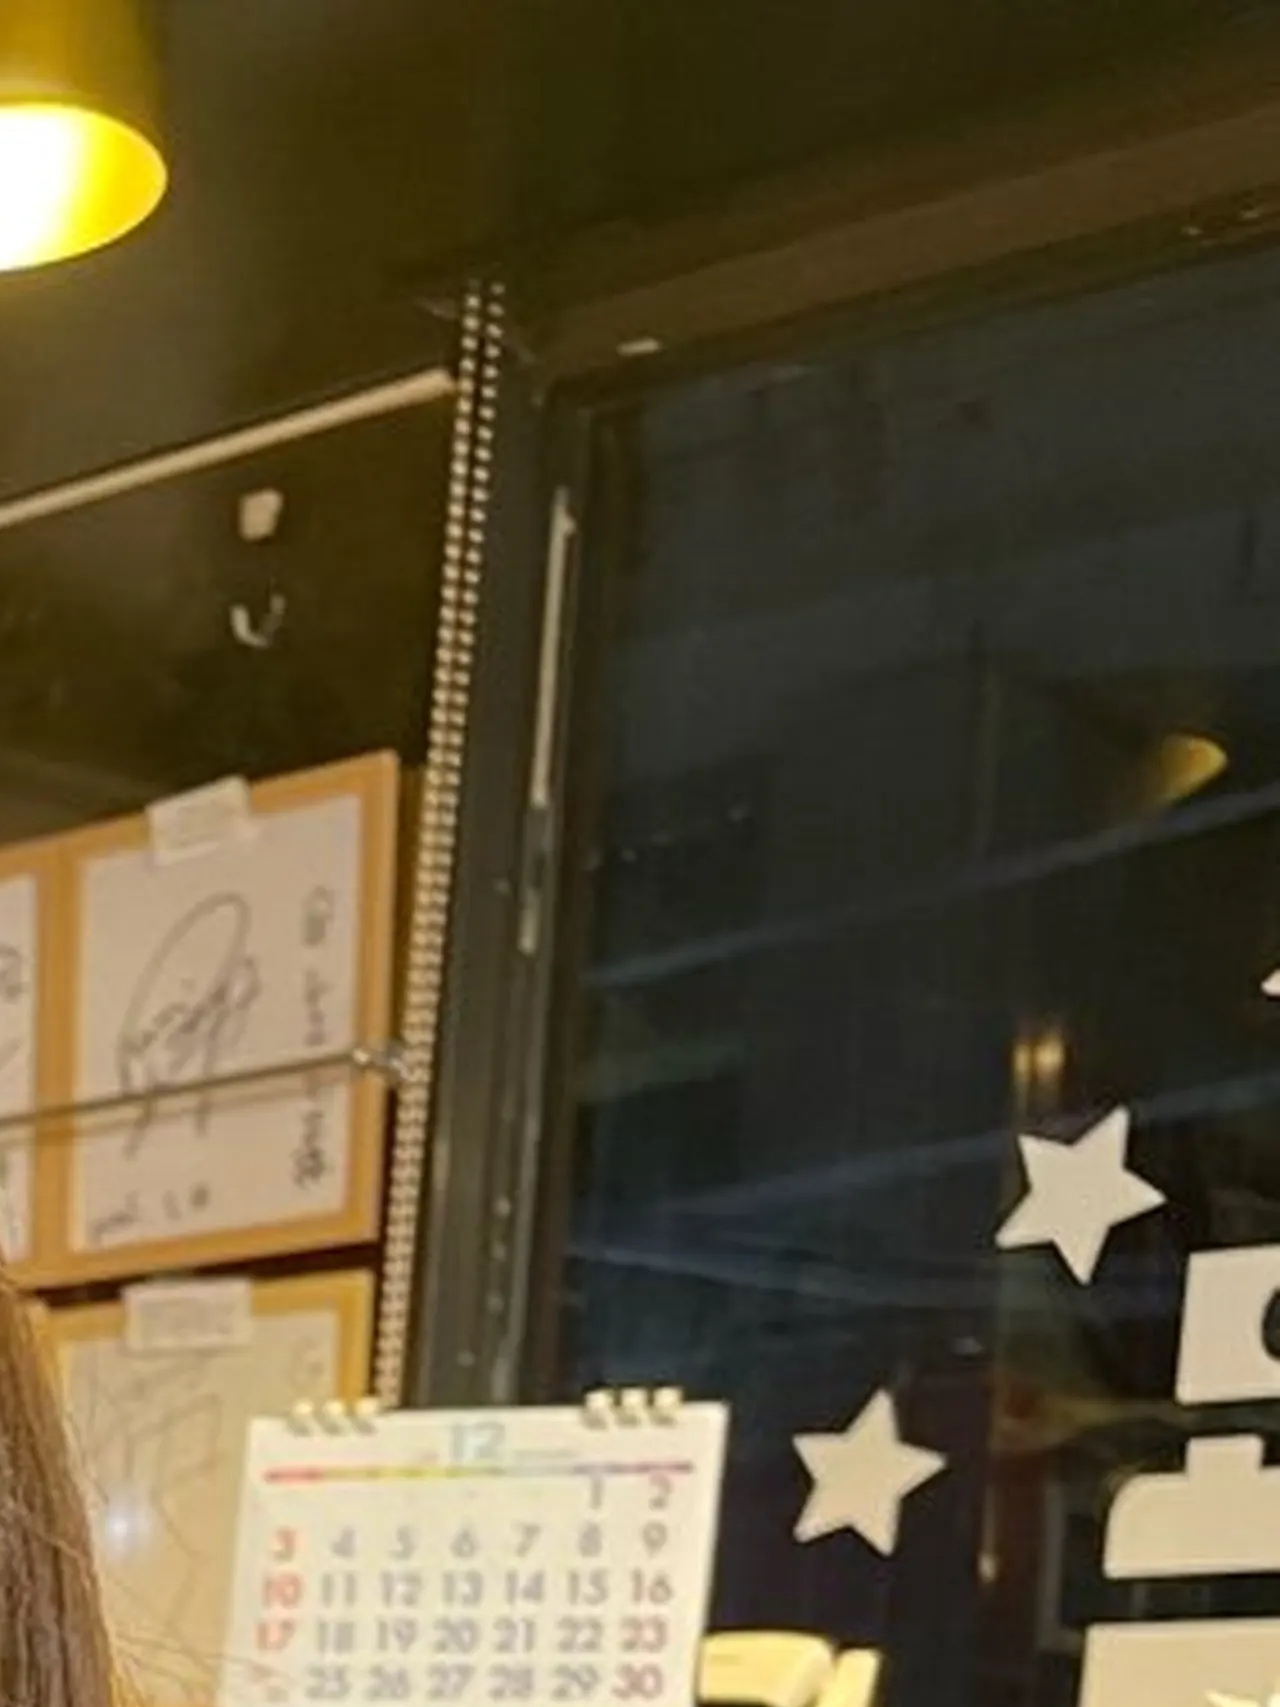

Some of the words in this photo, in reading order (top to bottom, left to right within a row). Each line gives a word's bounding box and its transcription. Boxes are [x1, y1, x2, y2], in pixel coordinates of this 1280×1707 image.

[587, 1477, 603, 1510] 1
[649, 1476, 672, 1509] 2
[274, 1528, 296, 1560] 3
[330, 1528, 355, 1558] 4
[393, 1526, 415, 1558] 5
[451, 1526, 478, 1558] 6
[516, 1524, 540, 1557] 7
[578, 1523, 603, 1556] 8
[642, 1521, 668, 1558] 9
[262, 1573, 301, 1607] 10
[321, 1572, 356, 1606] 11
[381, 1571, 422, 1606] 12
[442, 1570, 483, 1605] 13
[505, 1570, 543, 1604] 14
[566, 1570, 608, 1605] 15
[631, 1569, 672, 1602] 16
[257, 1620, 295, 1652] 17
[316, 1619, 354, 1653] 18
[375, 1618, 417, 1652] 19
[434, 1618, 478, 1653] 20
[493, 1618, 536, 1653] 21
[555, 1618, 603, 1653] 22
[620, 1617, 668, 1653] 23
[305, 1665, 350, 1700] 25
[365, 1665, 410, 1700] 26
[426, 1665, 475, 1700] 27
[489, 1664, 534, 1700] 28
[551, 1665, 599, 1700] 29
[612, 1665, 663, 1699] 30
